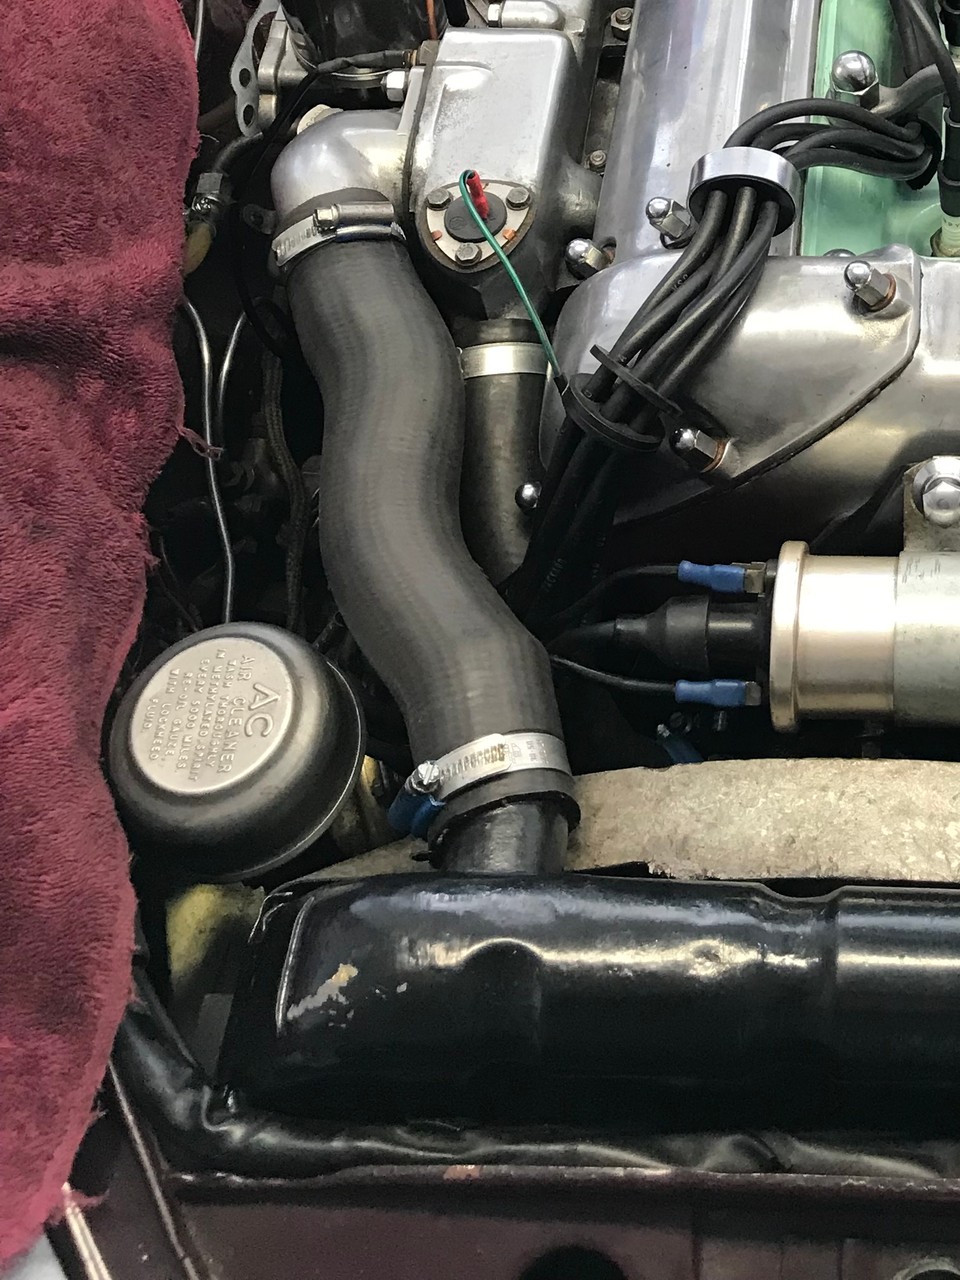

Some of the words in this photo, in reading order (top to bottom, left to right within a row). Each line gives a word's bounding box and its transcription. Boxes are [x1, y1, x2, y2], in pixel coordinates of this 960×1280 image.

[216, 649, 226, 659] IN
[237, 655, 255, 681] AIR
[166, 668, 180, 694] WITH
[194, 658, 210, 694] EVERY
[222, 659, 237, 688] WASH
[185, 700, 200, 730] 5000
[199, 665, 223, 738] METHYLATED
[244, 683, 281, 737] AC
[150, 703, 172, 761] LOCKHEED
[206, 695, 229, 768] THOROUGHLY
[217, 696, 246, 774] CLEANER
[189, 744, 205, 782] SPIRIT
